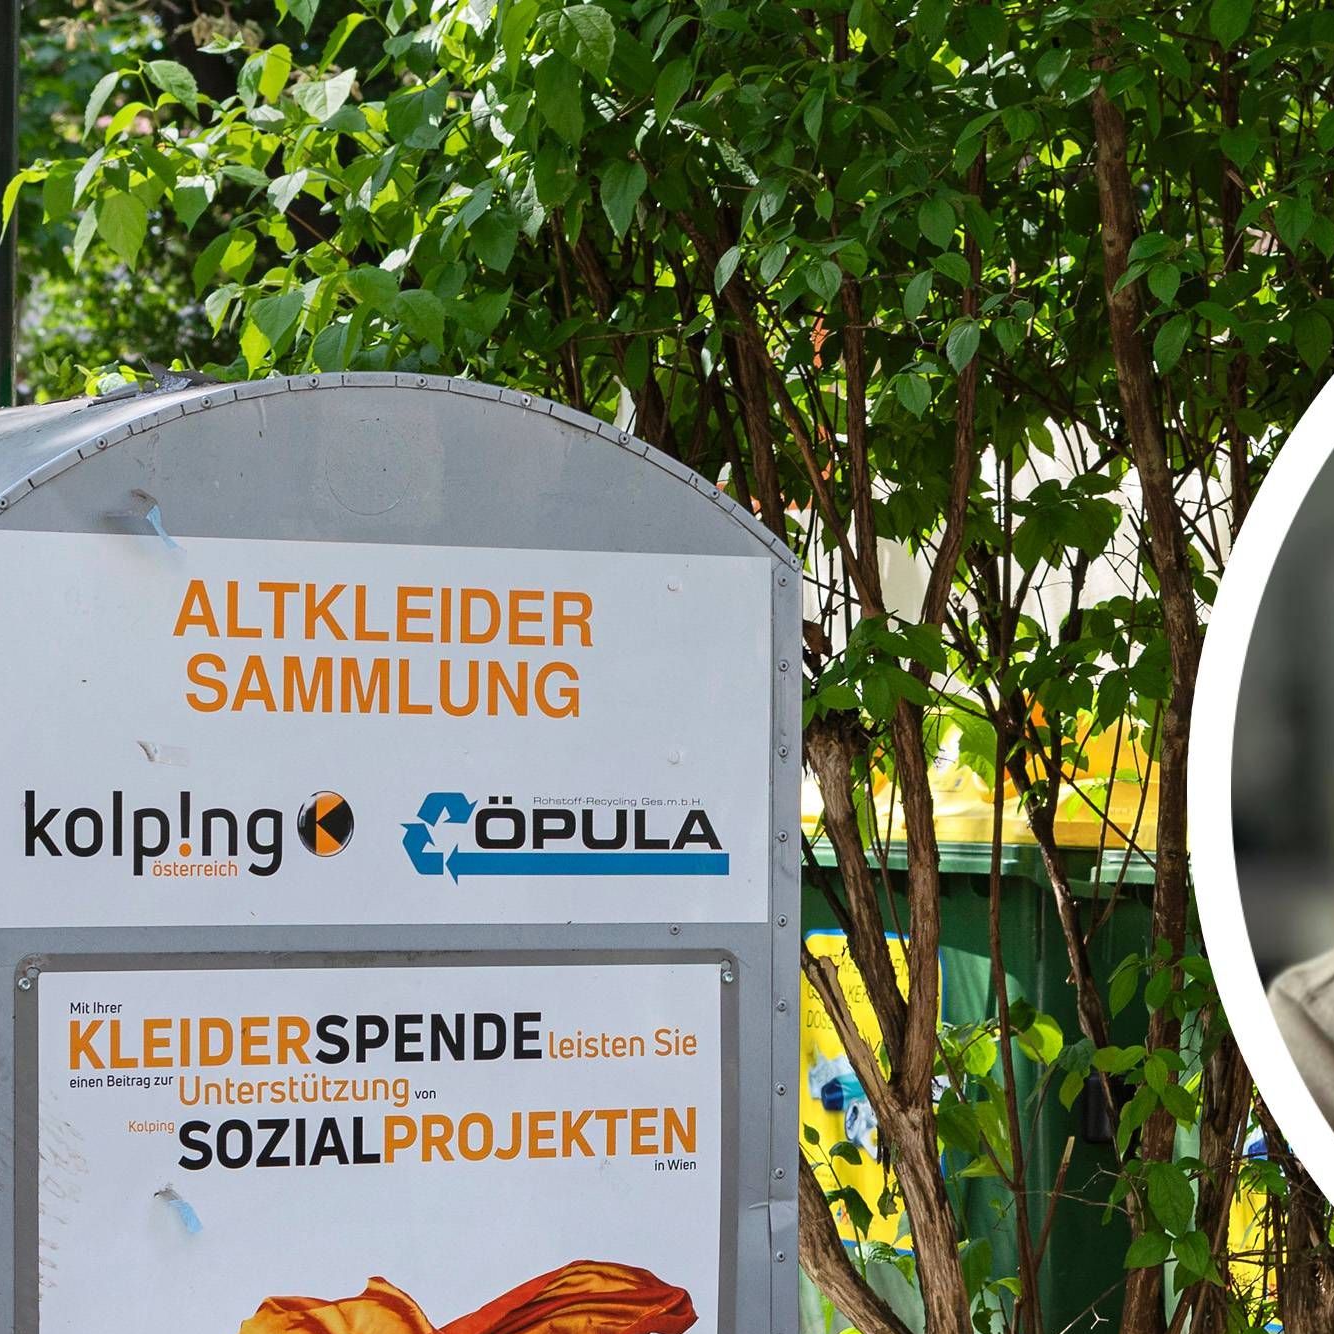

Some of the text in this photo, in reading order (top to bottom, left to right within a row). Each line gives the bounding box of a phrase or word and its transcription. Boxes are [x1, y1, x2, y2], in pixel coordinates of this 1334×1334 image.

[173, 580, 594, 647] ALTKLEIDER
[185, 653, 580, 718] SAMMLUNG
[475, 796, 723, 851] ÖPULA
[533, 796, 703, 807] Rohstoff-Recycling Ges.m.b.H.
[152, 859, 238, 878] österreich
[70, 1002, 123, 1013] Mit Ihrer
[70, 1012, 697, 1070] KLEIDERSPENDE leisten Sie
[70, 1075, 436, 1108] einen Beitrag zur Unterstützung von
[128, 1107, 697, 1170] Kolping SOZIALPROJEKTEN
[654, 1159, 697, 1171] in Wien
